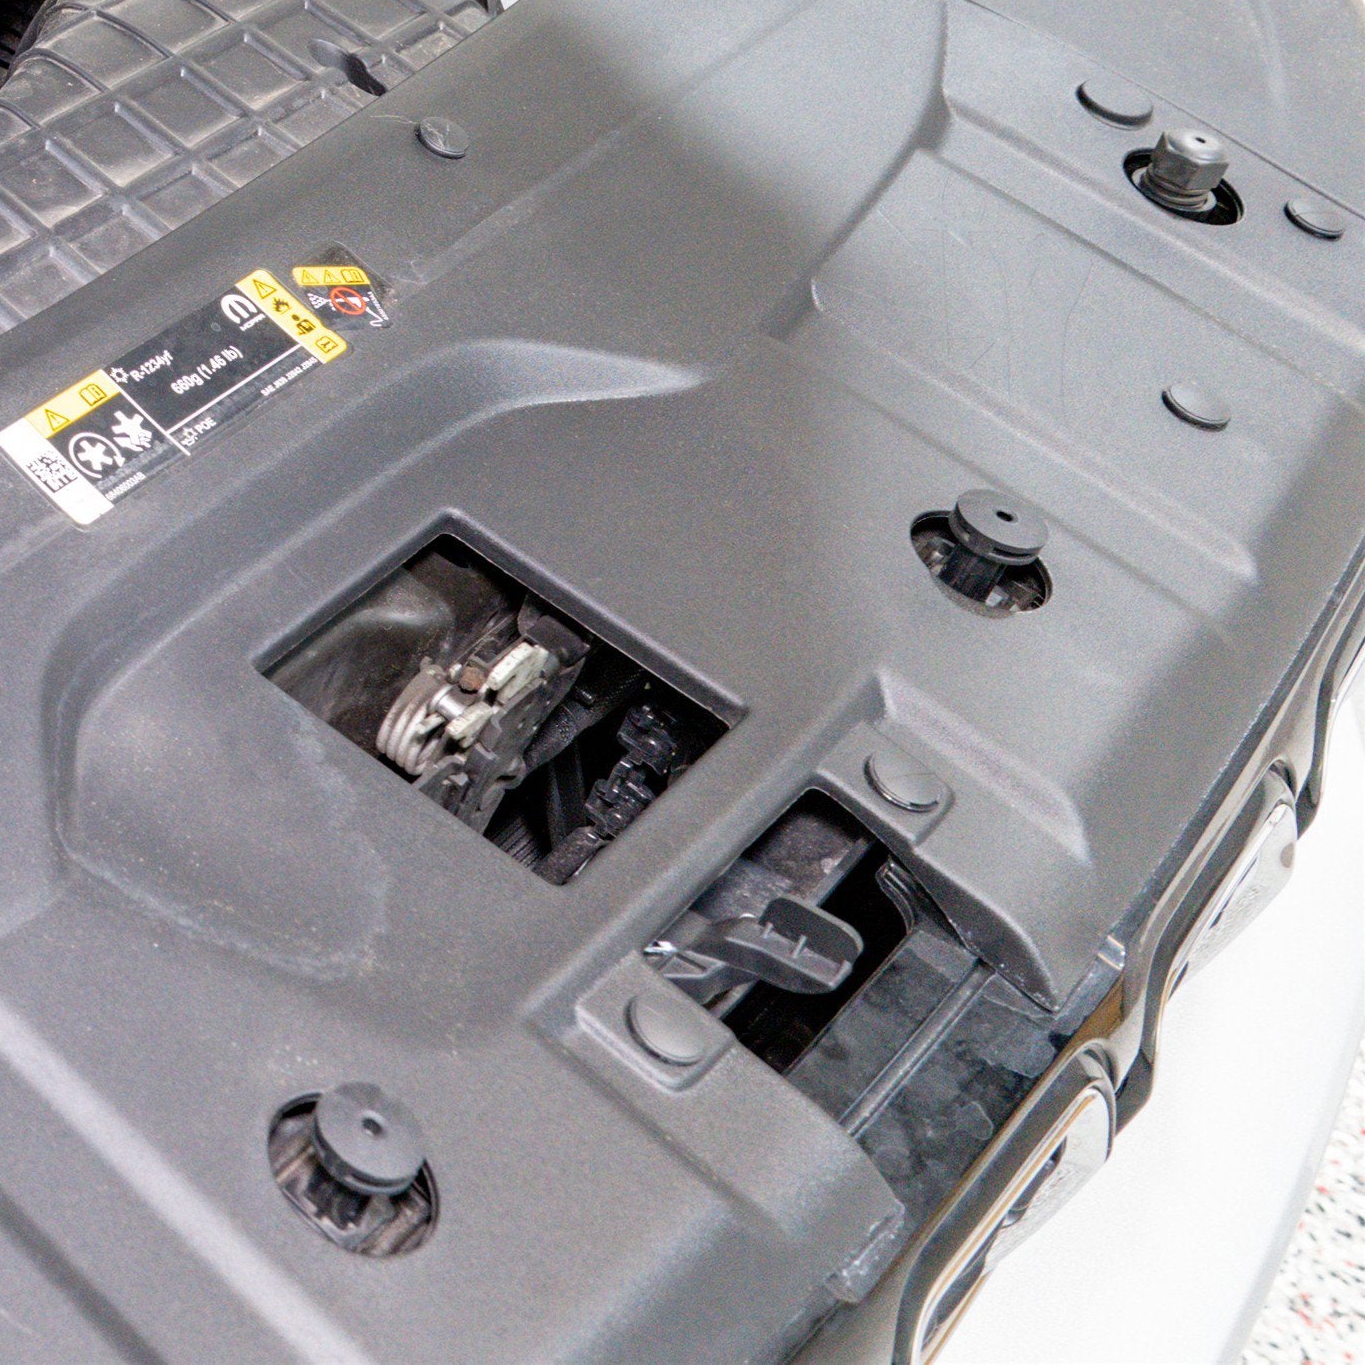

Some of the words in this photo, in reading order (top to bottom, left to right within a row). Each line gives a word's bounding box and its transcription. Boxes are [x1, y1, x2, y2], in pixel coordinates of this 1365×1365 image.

[170, 371, 204, 395] 660g
[196, 354, 228, 380] (1.46
[221, 345, 244, 364] lb)
[195, 416, 218, 434] POE
